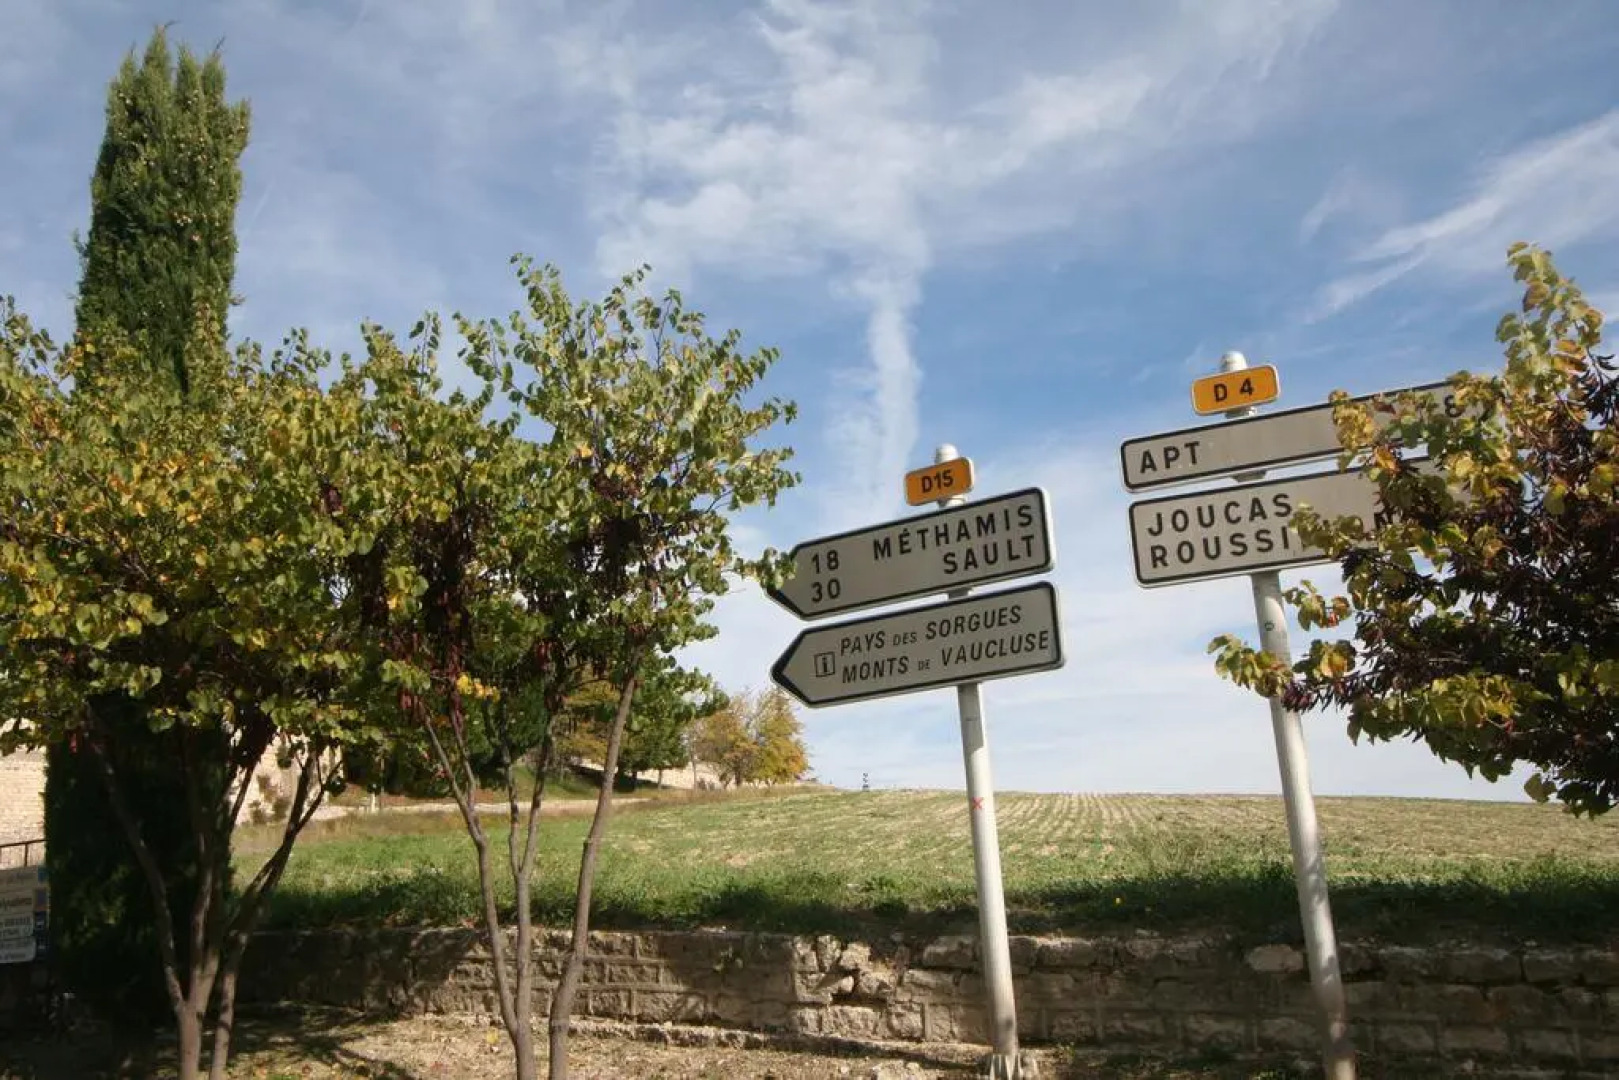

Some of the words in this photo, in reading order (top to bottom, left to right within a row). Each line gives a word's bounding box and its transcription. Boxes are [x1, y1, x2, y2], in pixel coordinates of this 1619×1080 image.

[1213, 383, 1229, 403] D
[1239, 378, 1256, 397] 4
[921, 469, 954, 494] D15
[1140, 441, 1201, 474] APT
[1147, 493, 1292, 537] JOUCAS
[811, 549, 840, 575] 18
[873, 505, 1033, 560] MÉTHAMIS
[811, 578, 841, 603] 30
[943, 535, 1035, 575] SAULT
[840, 631, 885, 657] PAYS
[893, 632, 917, 646] DES
[925, 605, 1021, 640] SORGUES
[842, 656, 909, 684] MONTS
[918, 659, 931, 671] DE
[941, 630, 1049, 667] VAUCLUSE
